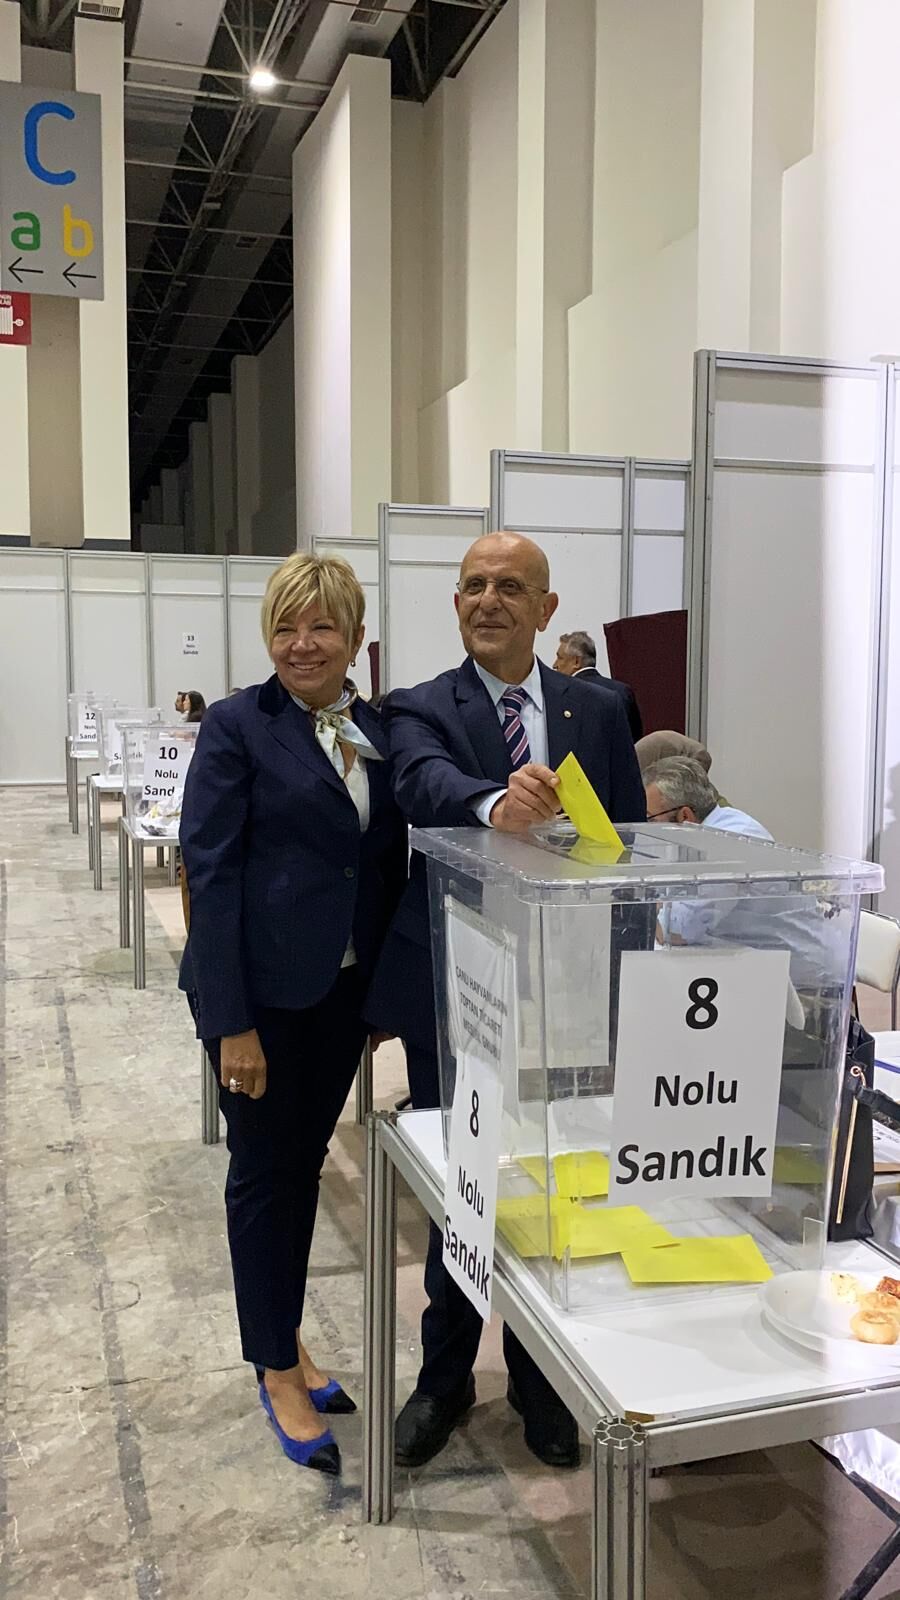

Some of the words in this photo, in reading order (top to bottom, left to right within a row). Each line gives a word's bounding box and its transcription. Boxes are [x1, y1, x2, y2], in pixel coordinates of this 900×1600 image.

[24, 101, 77, 186] C
[10, 211, 41, 251] a
[63, 203, 94, 258] b
[85, 712, 96, 720] 12
[154, 769, 179, 779] Nolu
[158, 746, 178, 760] 10
[144, 785, 175, 797] Sand
[684, 977, 719, 1030] 8
[469, 1089, 480, 1138] 8
[653, 1071, 738, 1108] Nolu
[615, 1135, 768, 1185] Sandık
[457, 1164, 484, 1219] Nolu
[444, 1214, 490, 1302] Sandık
